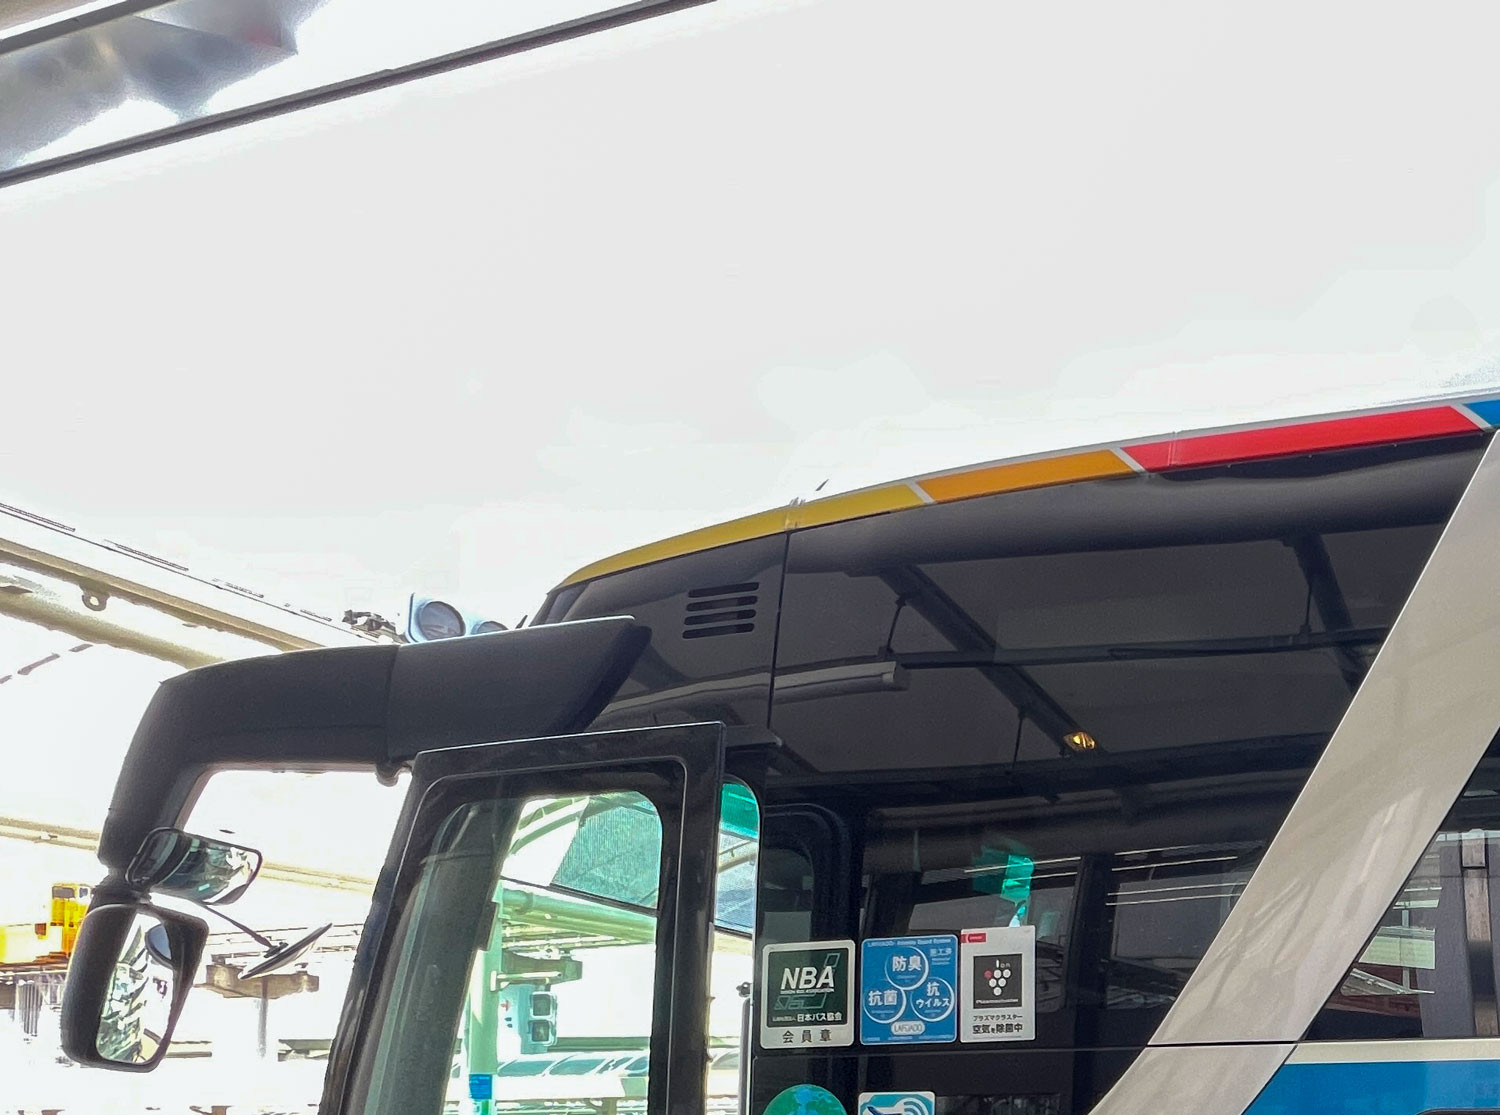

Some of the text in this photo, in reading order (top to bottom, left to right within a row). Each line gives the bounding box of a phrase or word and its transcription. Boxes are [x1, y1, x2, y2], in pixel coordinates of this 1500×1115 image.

[892, 955, 922, 972] 防臭
[781, 965, 835, 990] NBA
[868, 989, 898, 1006] 抗菌
[915, 997, 951, 1008] ウイルス
